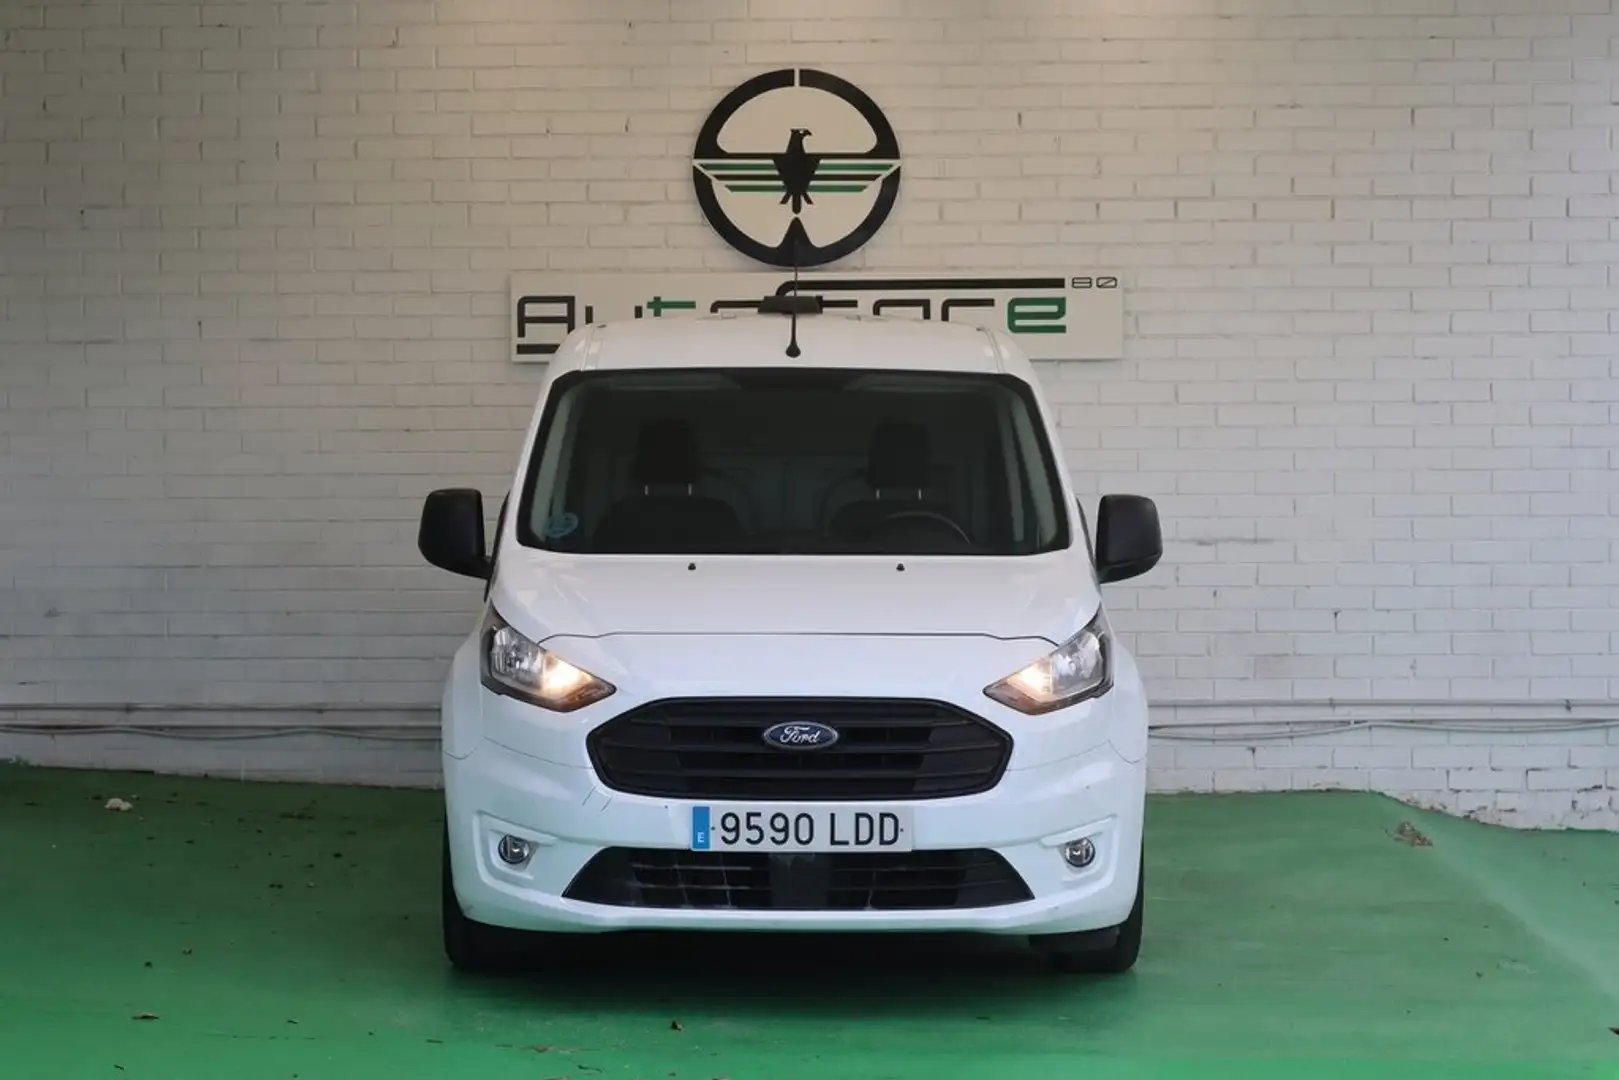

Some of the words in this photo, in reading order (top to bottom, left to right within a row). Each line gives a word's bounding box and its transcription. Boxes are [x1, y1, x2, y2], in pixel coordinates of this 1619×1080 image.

[1071, 276, 1118, 289] 80
[779, 725, 820, 744] Ford
[720, 811, 815, 845] 9590
[829, 812, 900, 846] LDD
[697, 831, 705, 844] E
